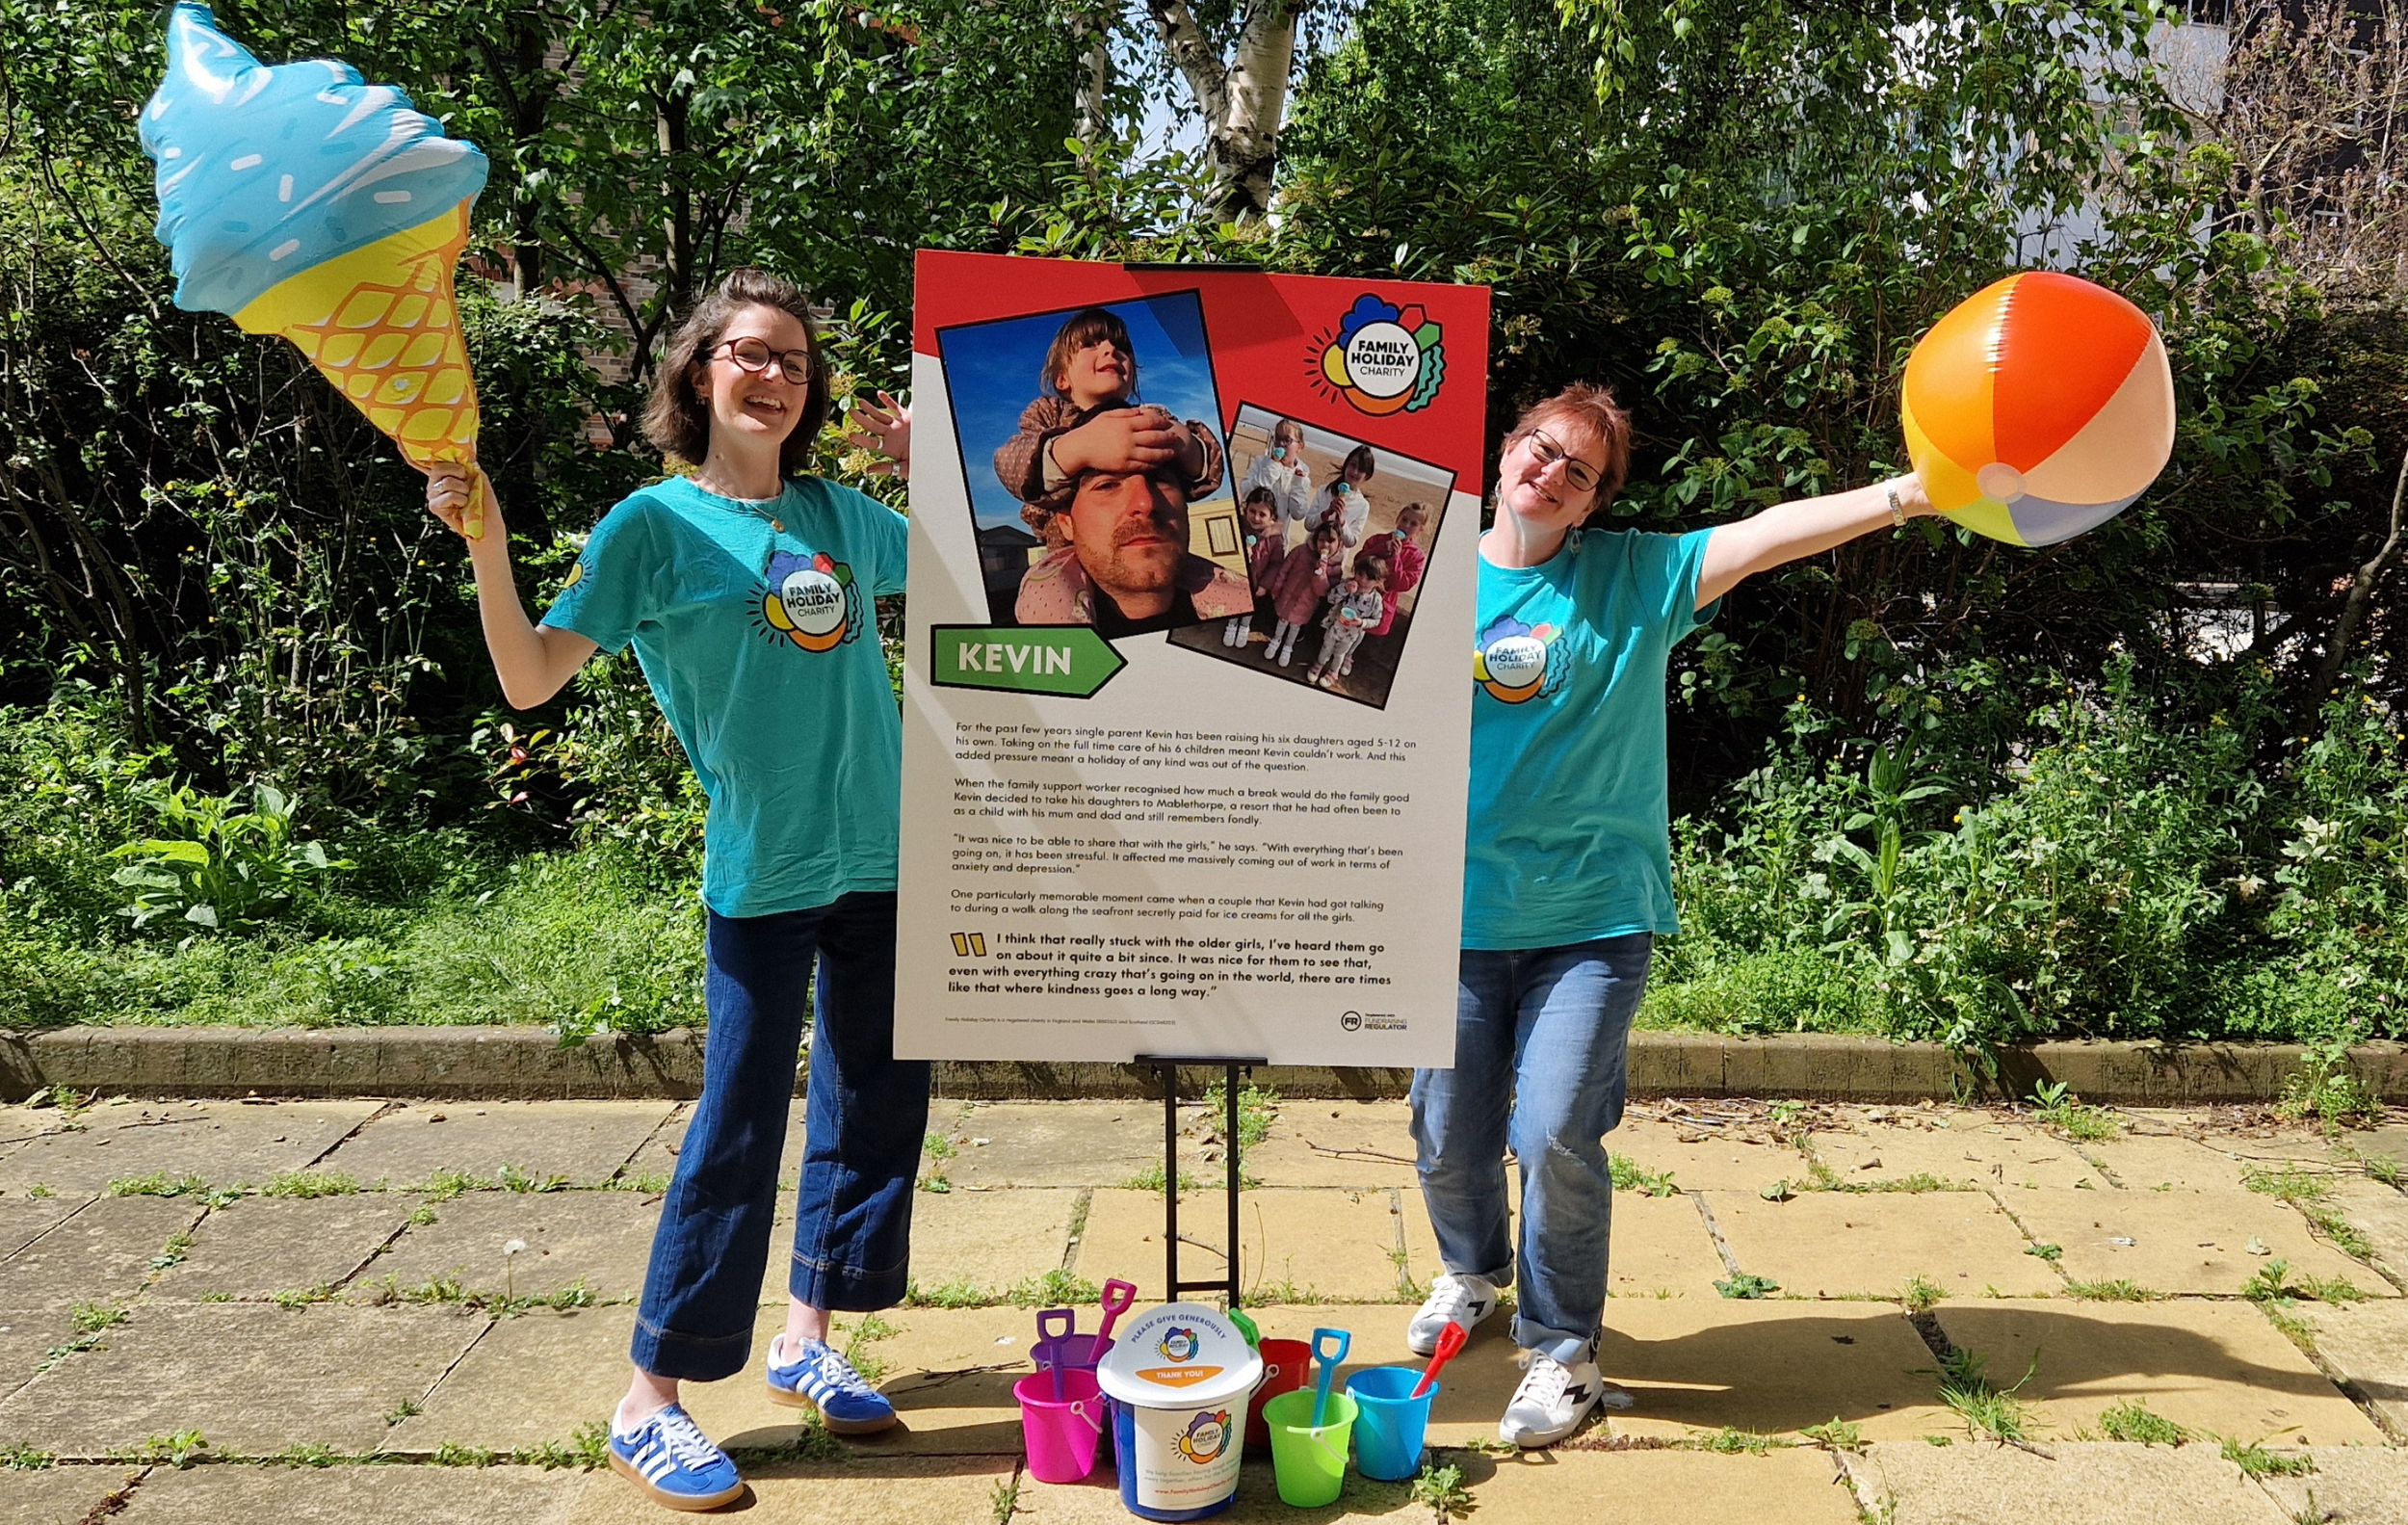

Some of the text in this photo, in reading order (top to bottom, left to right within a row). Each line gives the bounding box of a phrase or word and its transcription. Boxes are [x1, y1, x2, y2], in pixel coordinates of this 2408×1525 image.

[1358, 340, 1409, 354] FAMILY
[1351, 354, 1414, 366] HOLIDAY
[1360, 366, 1405, 377] CHARITY
[789, 583, 832, 596] FAMILY
[787, 593, 840, 608] HOLIDAY
[798, 606, 835, 617] CHARITY
[1490, 650, 1541, 662] HOLIDAY
[1496, 644, 1537, 654] FAMILY
[958, 643, 1071, 675] KEVIN
[1497, 662, 1534, 670] CHARITY
[956, 722, 973, 732] For
[976, 723, 992, 732] the
[996, 725, 1018, 736] past
[1022, 723, 1040, 734] few
[1044, 727, 1071, 738] years
[1075, 726, 1104, 740] single
[1108, 730, 1142, 740] parent
[1146, 729, 1172, 740] Kevin
[1176, 730, 1192, 740] has
[1196, 730, 1221, 741] been
[1225, 732, 1258, 746] raising
[1262, 733, 1275, 743] his
[1278, 734, 1290, 744] six
[1294, 734, 1344, 748] daughters
[1348, 737, 1374, 749] aged
[1377, 738, 1400, 748] 5-12
[955, 777, 984, 788] When
[988, 778, 1004, 788] the
[1008, 778, 1039, 793] family
[1042, 783, 1083, 794] support
[1085, 782, 1121, 792] worker
[1124, 785, 1181, 797] recognised
[1184, 785, 1205, 795] how
[1208, 787, 1235, 797] much
[1248, 787, 1278, 798] break
[1280, 789, 1311, 799] would
[1314, 790, 1327, 800] do
[1331, 790, 1347, 800] the
[1349, 791, 1379, 804] family
[1383, 793, 1409, 804] good
[952, 848, 982, 860] going
[985, 851, 1002, 859] on,
[1006, 849, 1013, 858] it
[1015, 849, 1033, 859] has
[1036, 850, 1062, 859] been
[1065, 851, 1109, 860] stressful.
[1113, 852, 1119, 861] It
[1122, 852, 1165, 862] affected
[1188, 855, 1235, 867] massively
[1239, 856, 1275, 869] coming
[1296, 857, 1308, 867] of
[1310, 858, 1335, 867] work
[1338, 859, 1347, 868] in
[1349, 860, 1376, 869] terms
[1379, 859, 1391, 869] of
[952, 861, 989, 874] anxiety
[992, 862, 1013, 872] and
[997, 933, 1001, 944] I
[1006, 933, 1036, 944] think
[1040, 933, 1065, 945] that
[1069, 934, 1107, 949] really
[1110, 935, 1140, 946] stuck
[1144, 936, 1171, 947] with
[1175, 936, 1194, 948] the
[1198, 937, 1231, 949] older
[1235, 938, 1265, 954] girls,
[1295, 939, 1331, 951] heard
[1335, 940, 1365, 952] them
[1369, 945, 1385, 956] go
[996, 952, 1011, 960] on
[1015, 948, 1054, 961] about
[1058, 950, 1065, 961] it
[1067, 951, 1102, 965] quite
[1118, 951, 1136, 962] bit
[1139, 952, 1173, 963] since.
[1178, 953, 1187, 963] It
[1218, 954, 1243, 964] nice
[1245, 954, 1268, 965] for
[1269, 955, 1299, 966] them
[1303, 958, 1316, 966] to
[1343, 957, 1372, 970] that,
[982, 965, 1009, 977] with
[1013, 966, 1080, 981] everything
[1084, 970, 1117, 982] crazy
[1160, 969, 1195, 984] going
[1217, 970, 1229, 981] in
[1233, 970, 1252, 981] the
[1256, 971, 1296, 985] world,
[1298, 971, 1331, 983] there
[1359, 974, 1391, 985] times
[949, 981, 971, 992] like
[975, 982, 1001, 993] that
[1004, 982, 1043, 993] where
[1048, 983, 1100, 994] kindness
[1104, 987, 1134, 998] goes
[1150, 985, 1177, 1000] long
[1131, 1314, 1227, 1343] PLEASE GIVE GENEROUSLY
[1193, 1433, 1220, 1443] HOLIDAY
